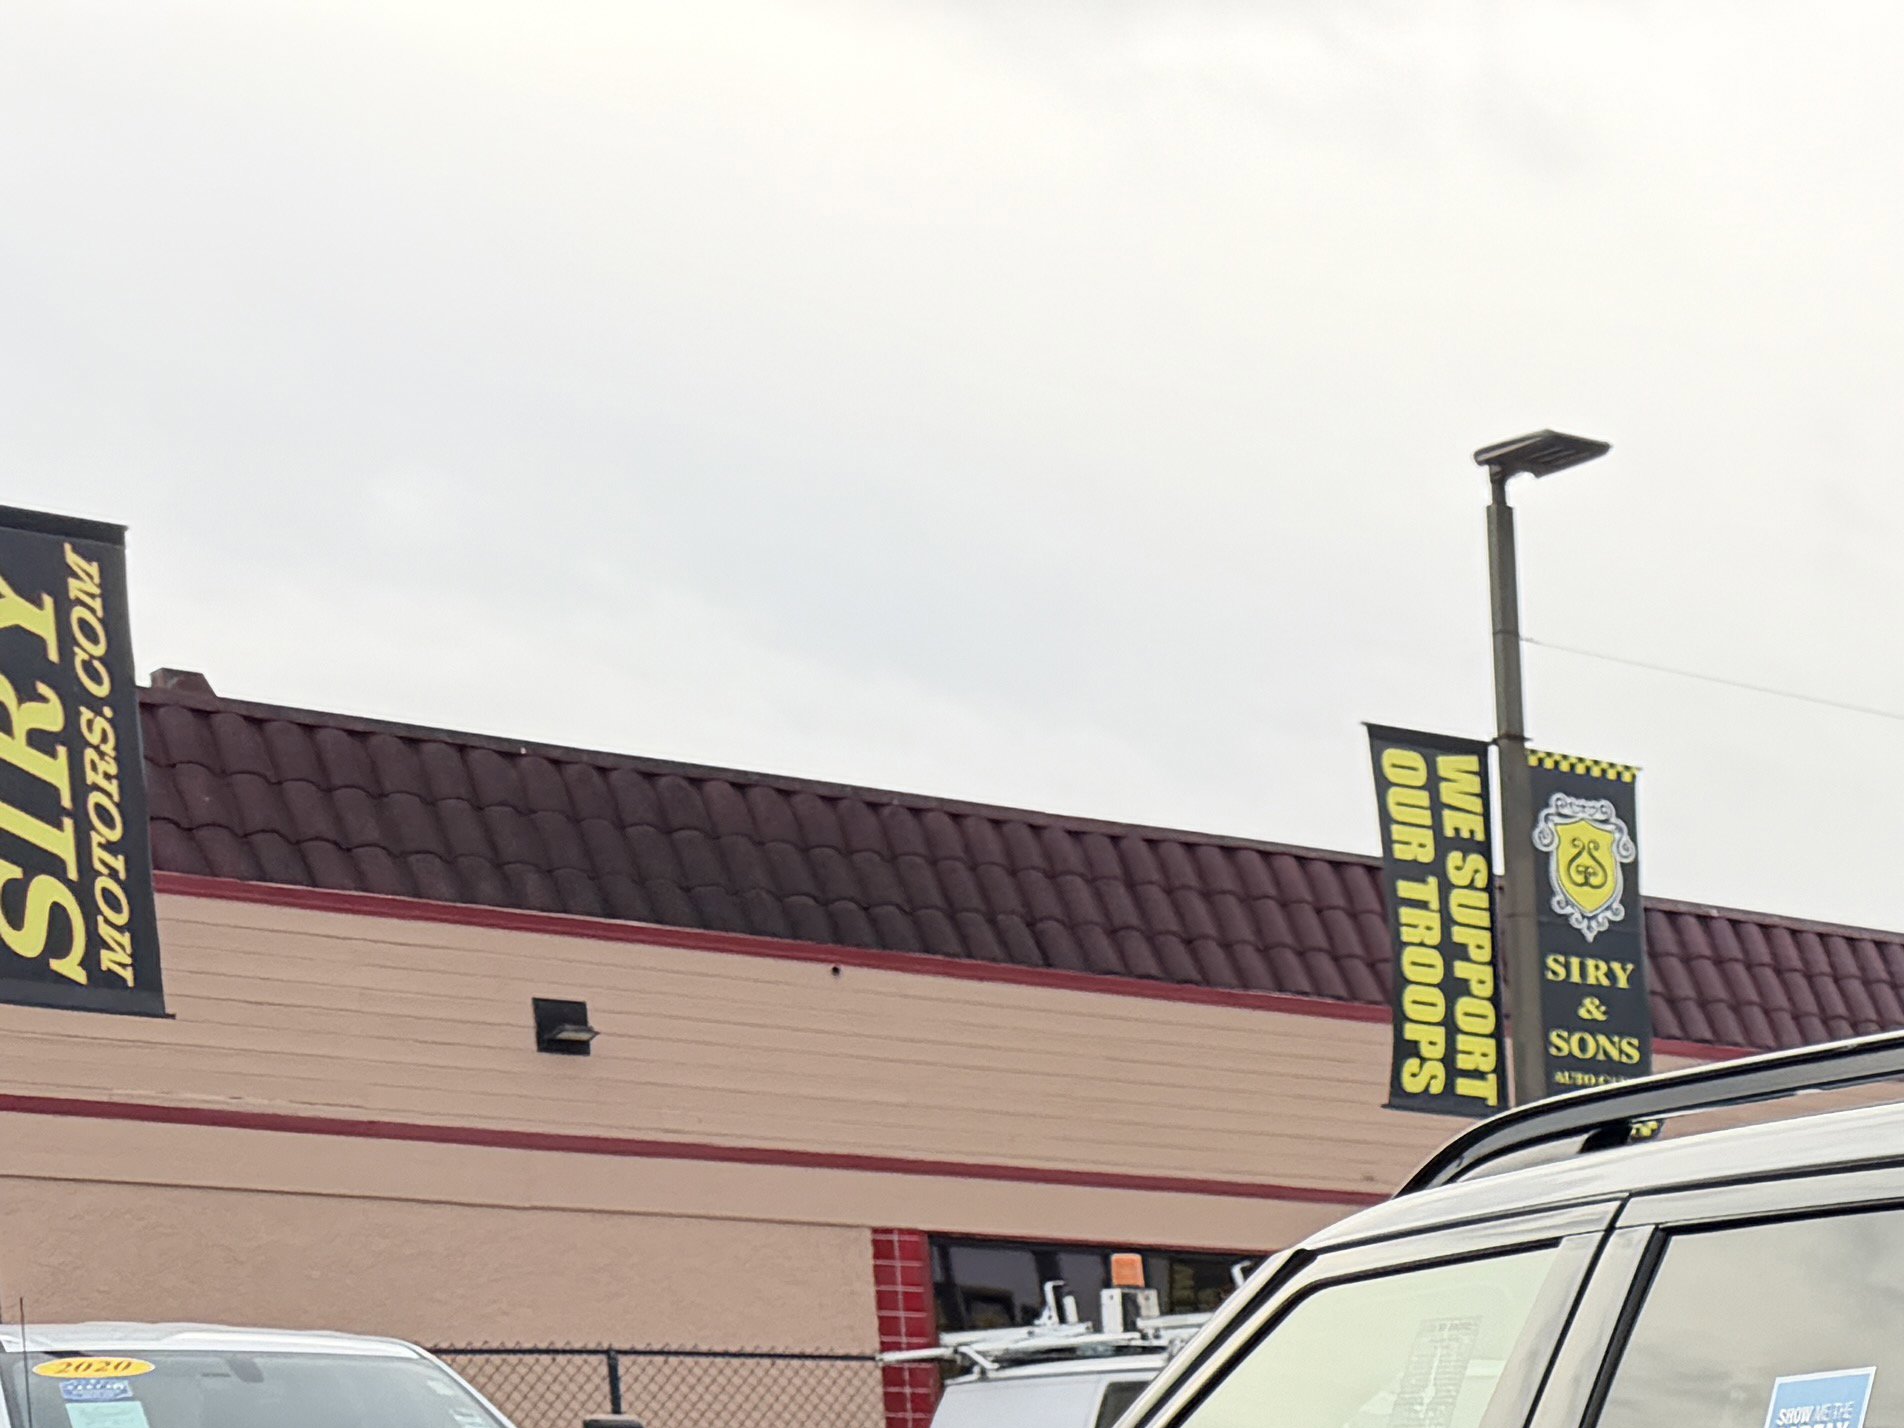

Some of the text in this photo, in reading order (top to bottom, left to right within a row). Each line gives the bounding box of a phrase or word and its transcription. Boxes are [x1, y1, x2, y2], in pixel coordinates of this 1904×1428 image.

[63, 542, 135, 988] MOTORS.COM
[1381, 747, 1446, 1095] OUR TROOPS
[1436, 755, 1498, 1107] WE SUPPORT
[1544, 954, 1635, 989] SIRY
[1576, 996, 1609, 1021] &
[1549, 1029, 1641, 1065] SONS
[54, 1361, 131, 1374] 2020
[1776, 1406, 1814, 1426] SHOW
